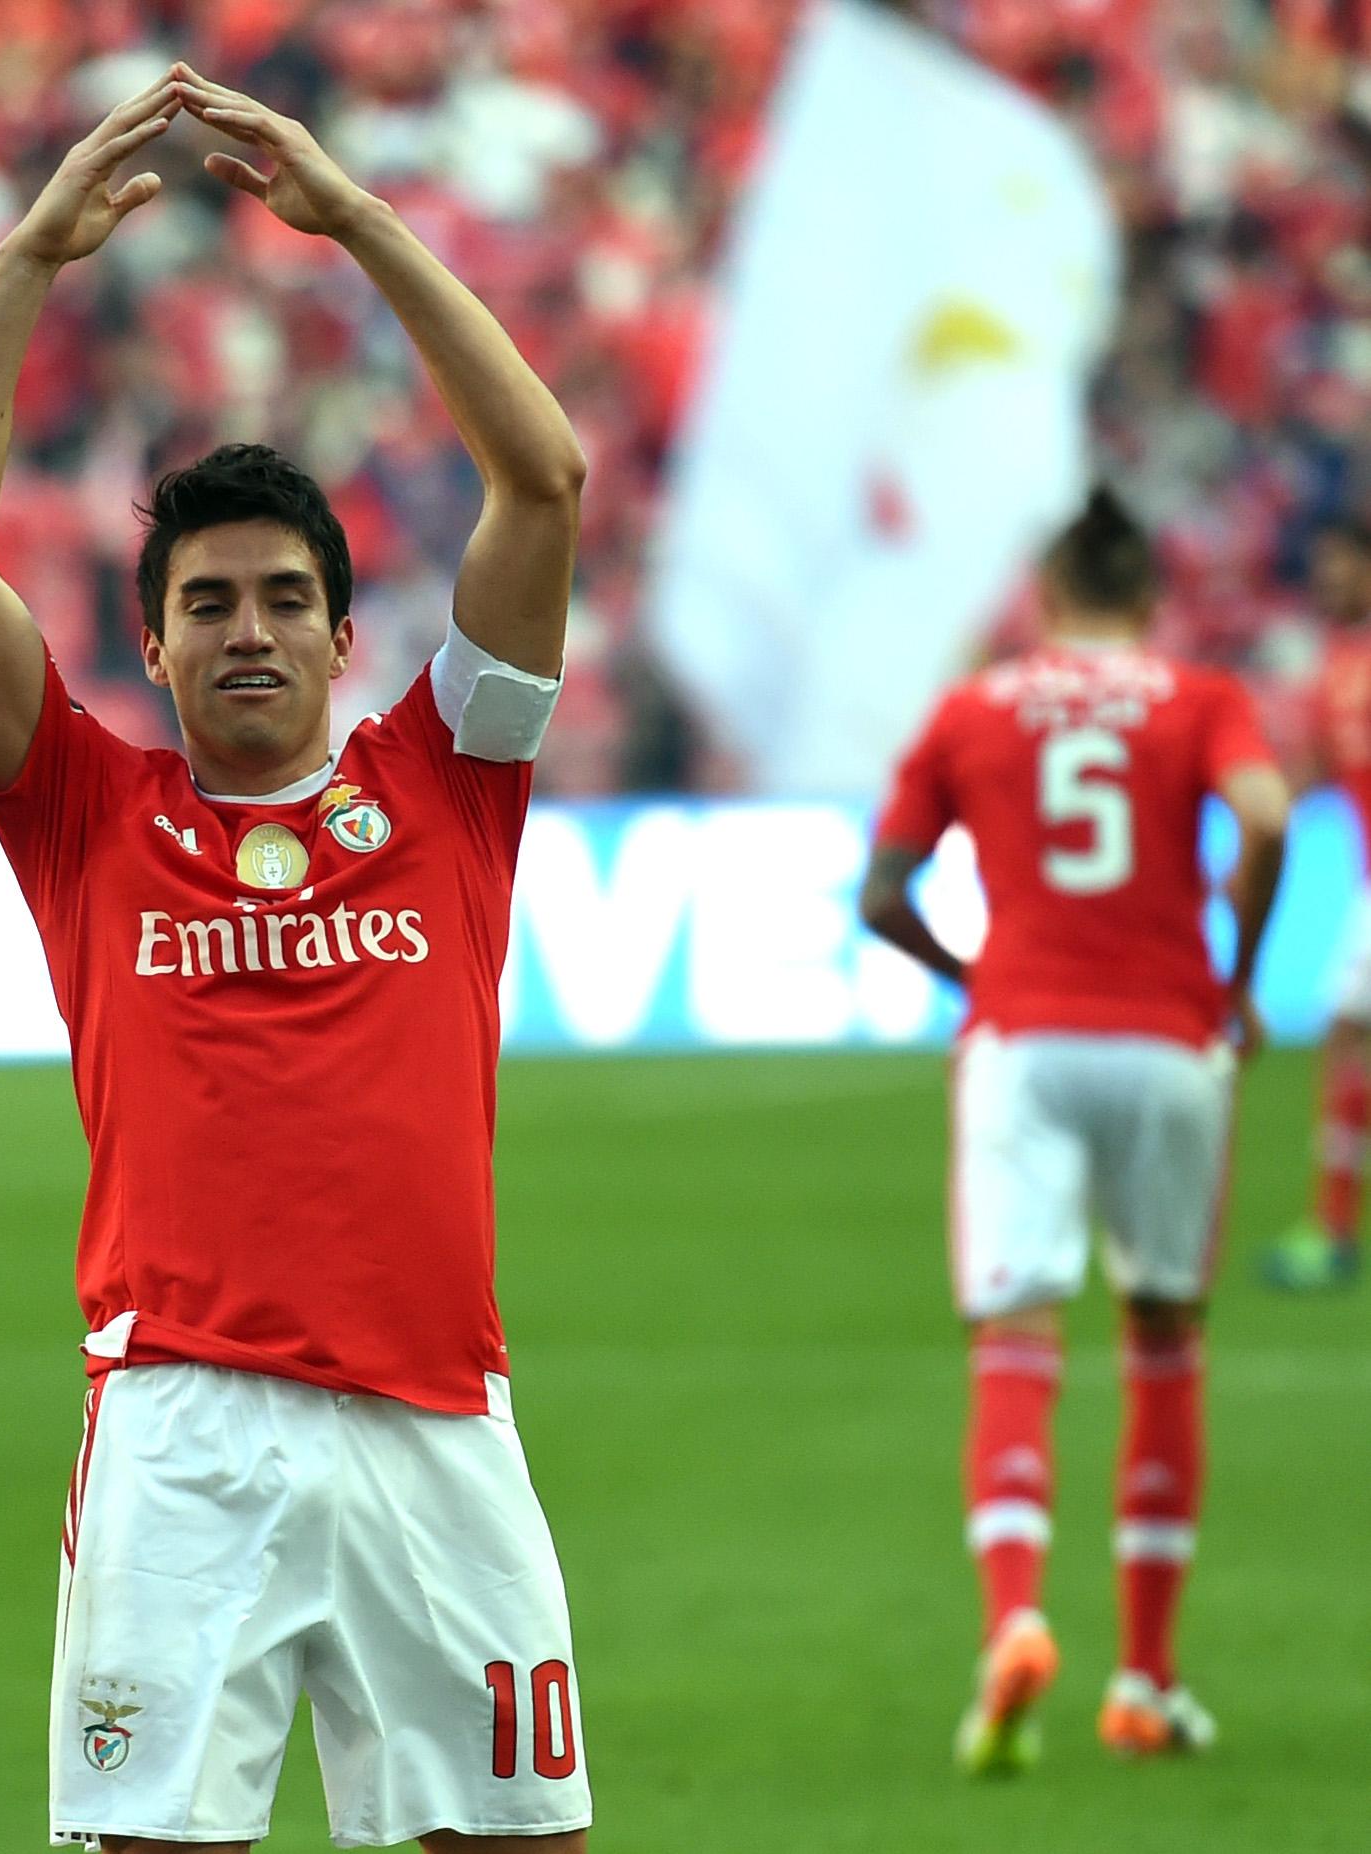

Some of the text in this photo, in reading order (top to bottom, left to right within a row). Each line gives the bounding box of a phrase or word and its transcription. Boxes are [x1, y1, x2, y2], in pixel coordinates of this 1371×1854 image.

[1039, 727, 1134, 895] 5
[135, 901, 429, 977] Emirates
[484, 1659, 577, 1780] 10
